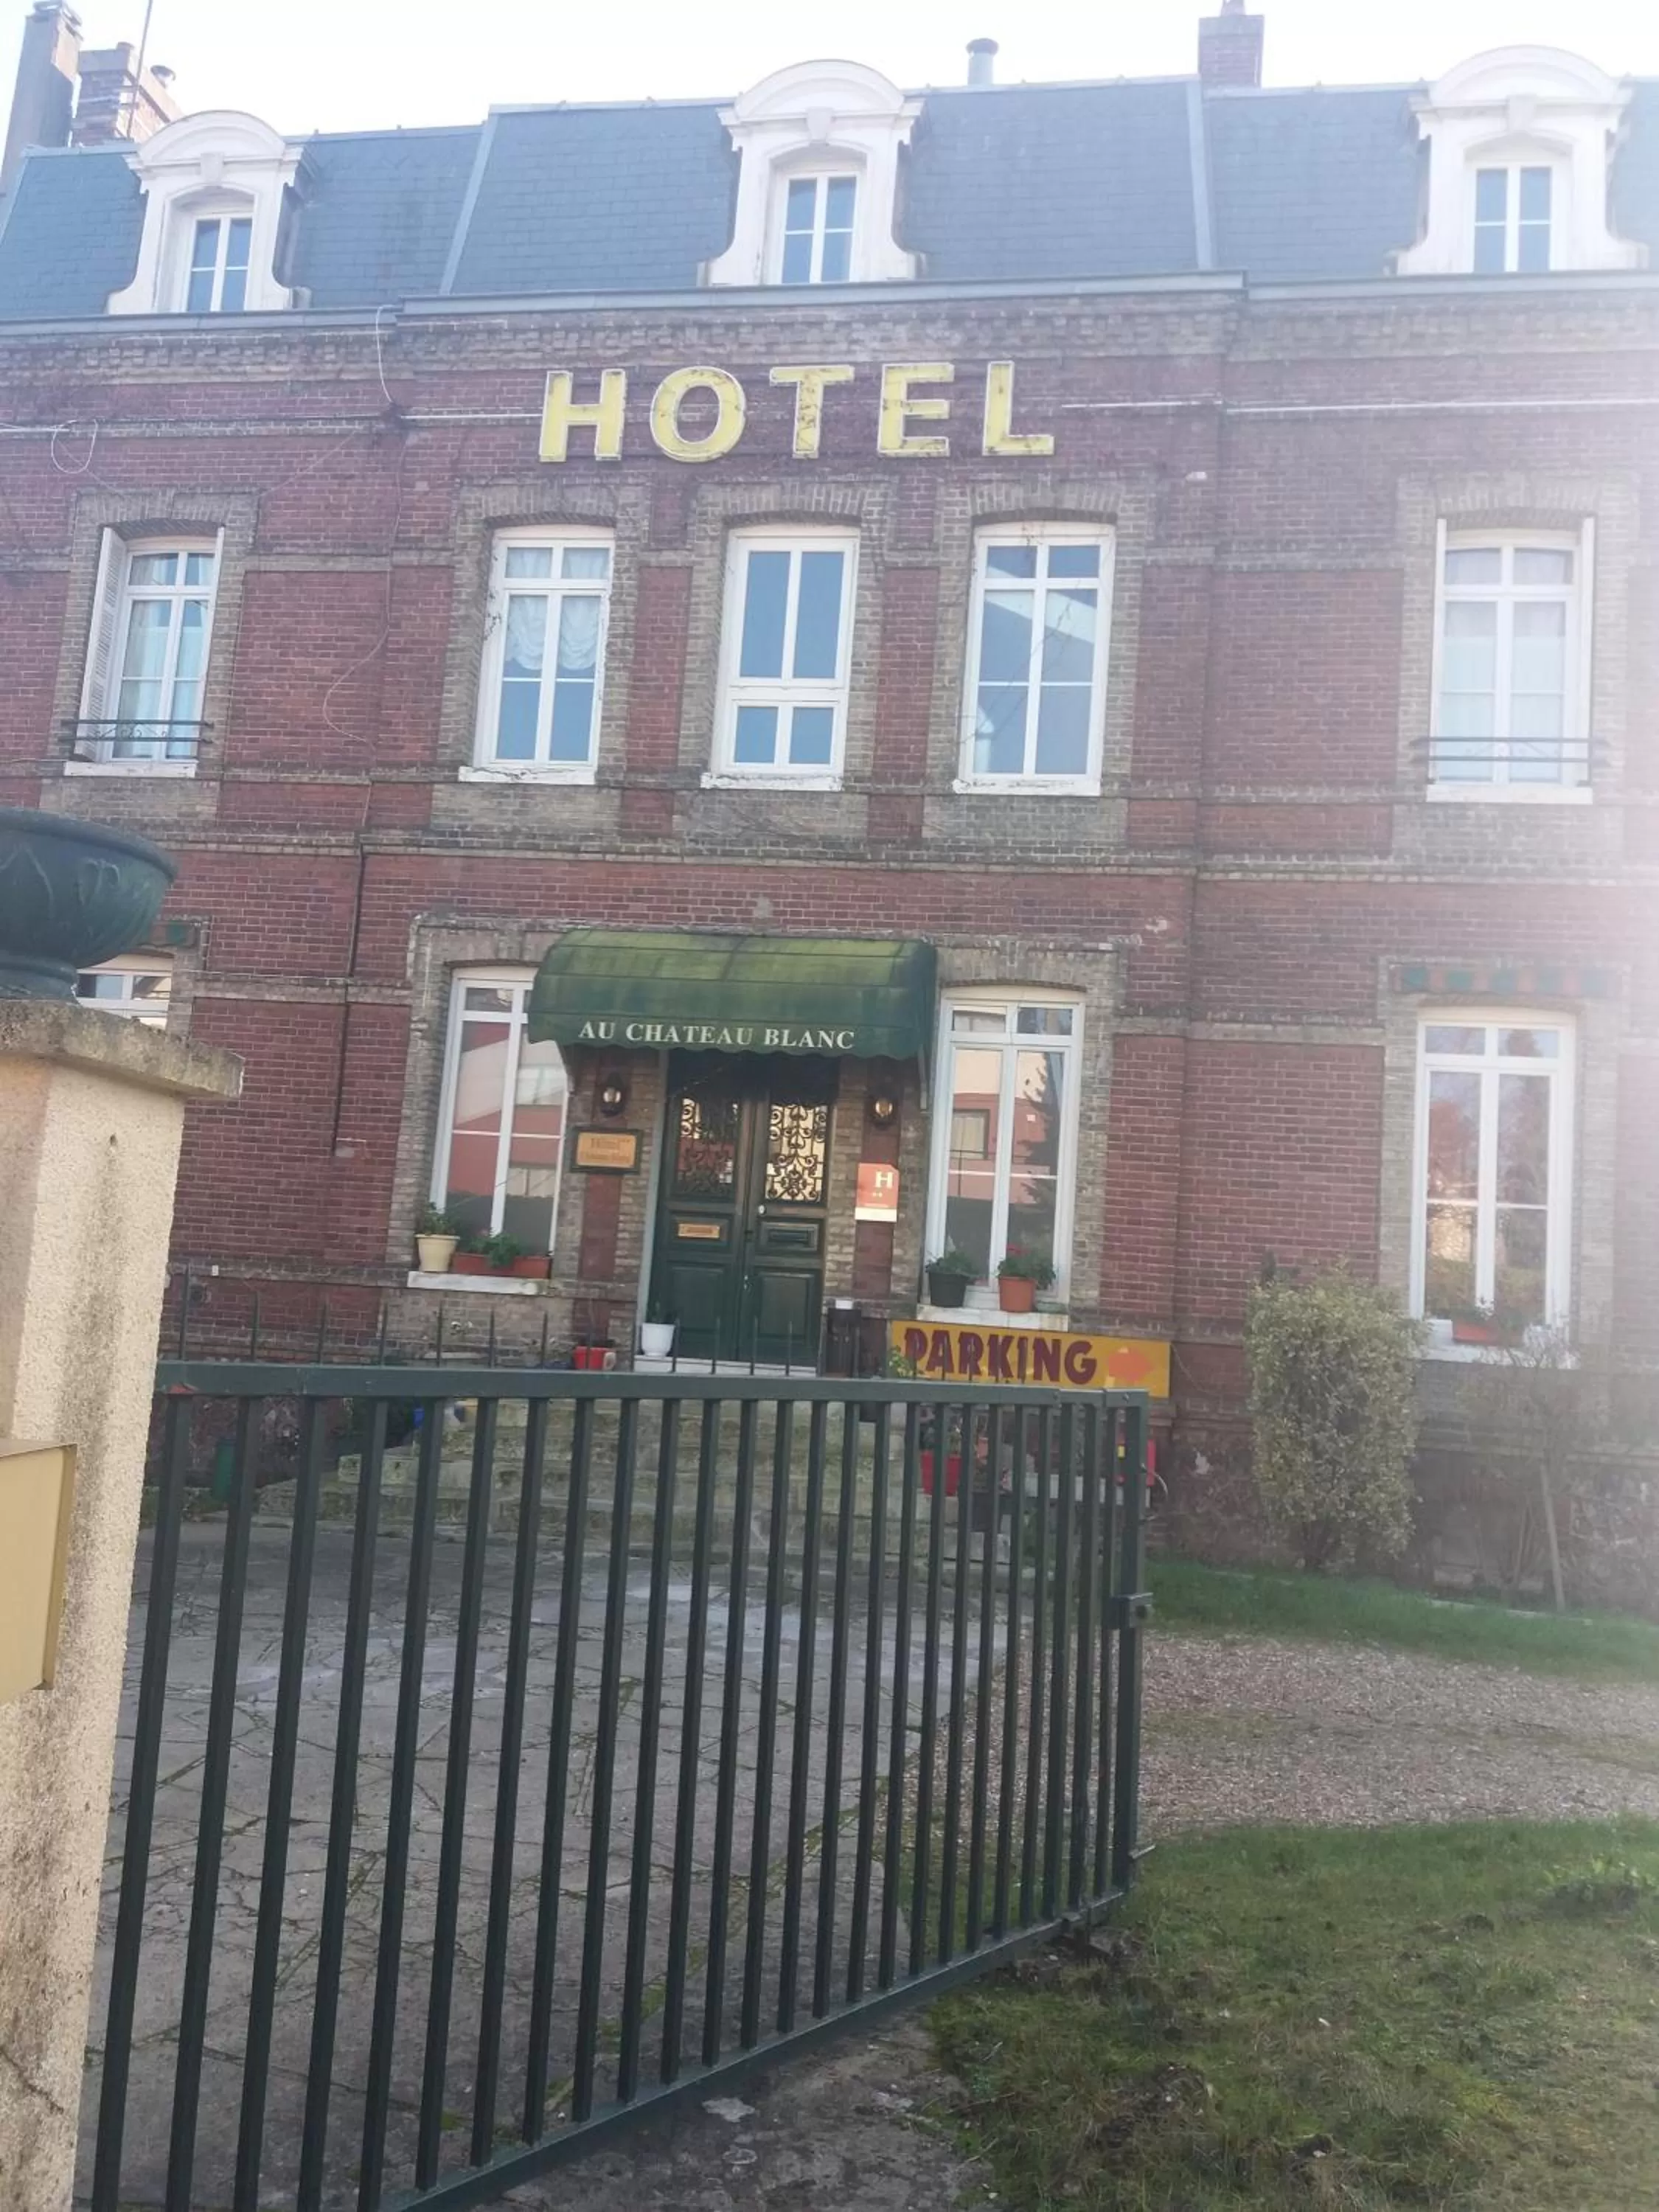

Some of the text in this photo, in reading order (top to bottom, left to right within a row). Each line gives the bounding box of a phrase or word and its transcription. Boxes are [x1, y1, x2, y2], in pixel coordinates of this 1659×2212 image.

[538, 361, 1055, 462] HOTEL
[578, 1021, 855, 1049] AU CHATEAU BLANC
[875, 1171, 893, 1189] H
[904, 1327, 1098, 1385] PARKING
